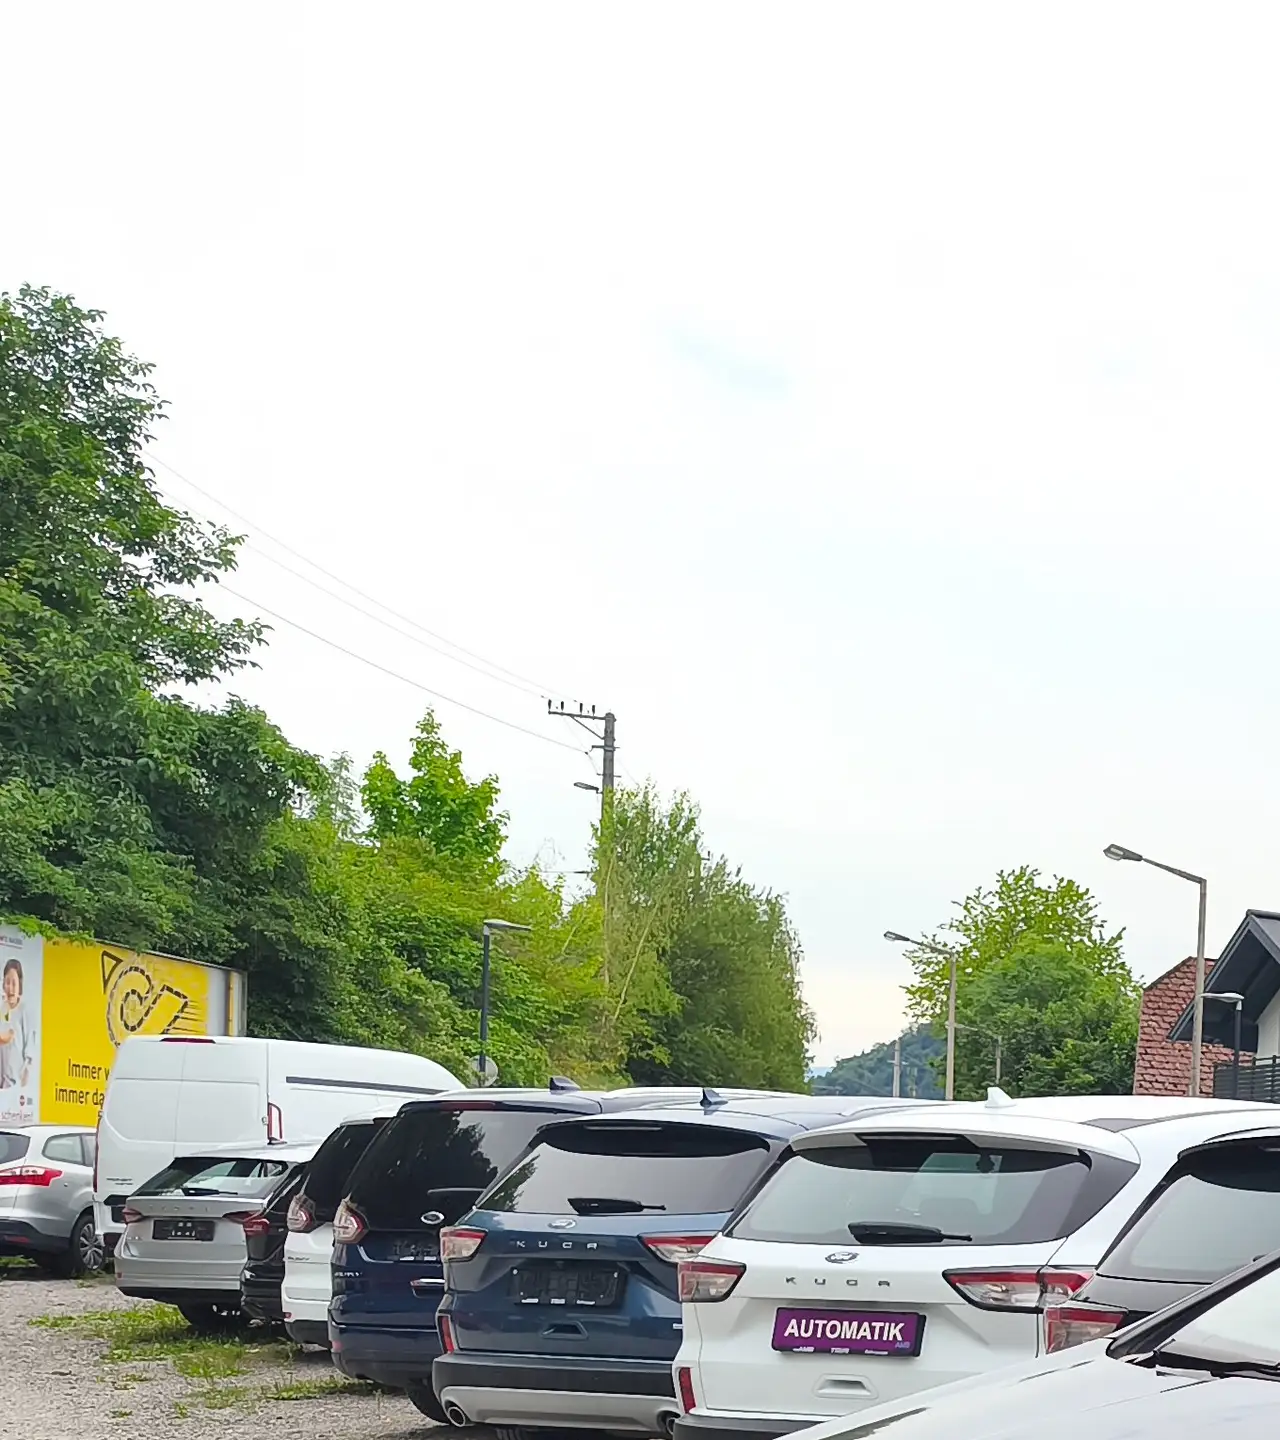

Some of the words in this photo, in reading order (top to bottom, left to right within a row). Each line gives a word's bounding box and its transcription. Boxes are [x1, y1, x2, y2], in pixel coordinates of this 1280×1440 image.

[67, 1058, 102, 1081] Immer
[55, 1082, 90, 1105] immer
[785, 1276, 891, 1288] KUGA
[784, 1318, 905, 1341] AUTOMATIK
